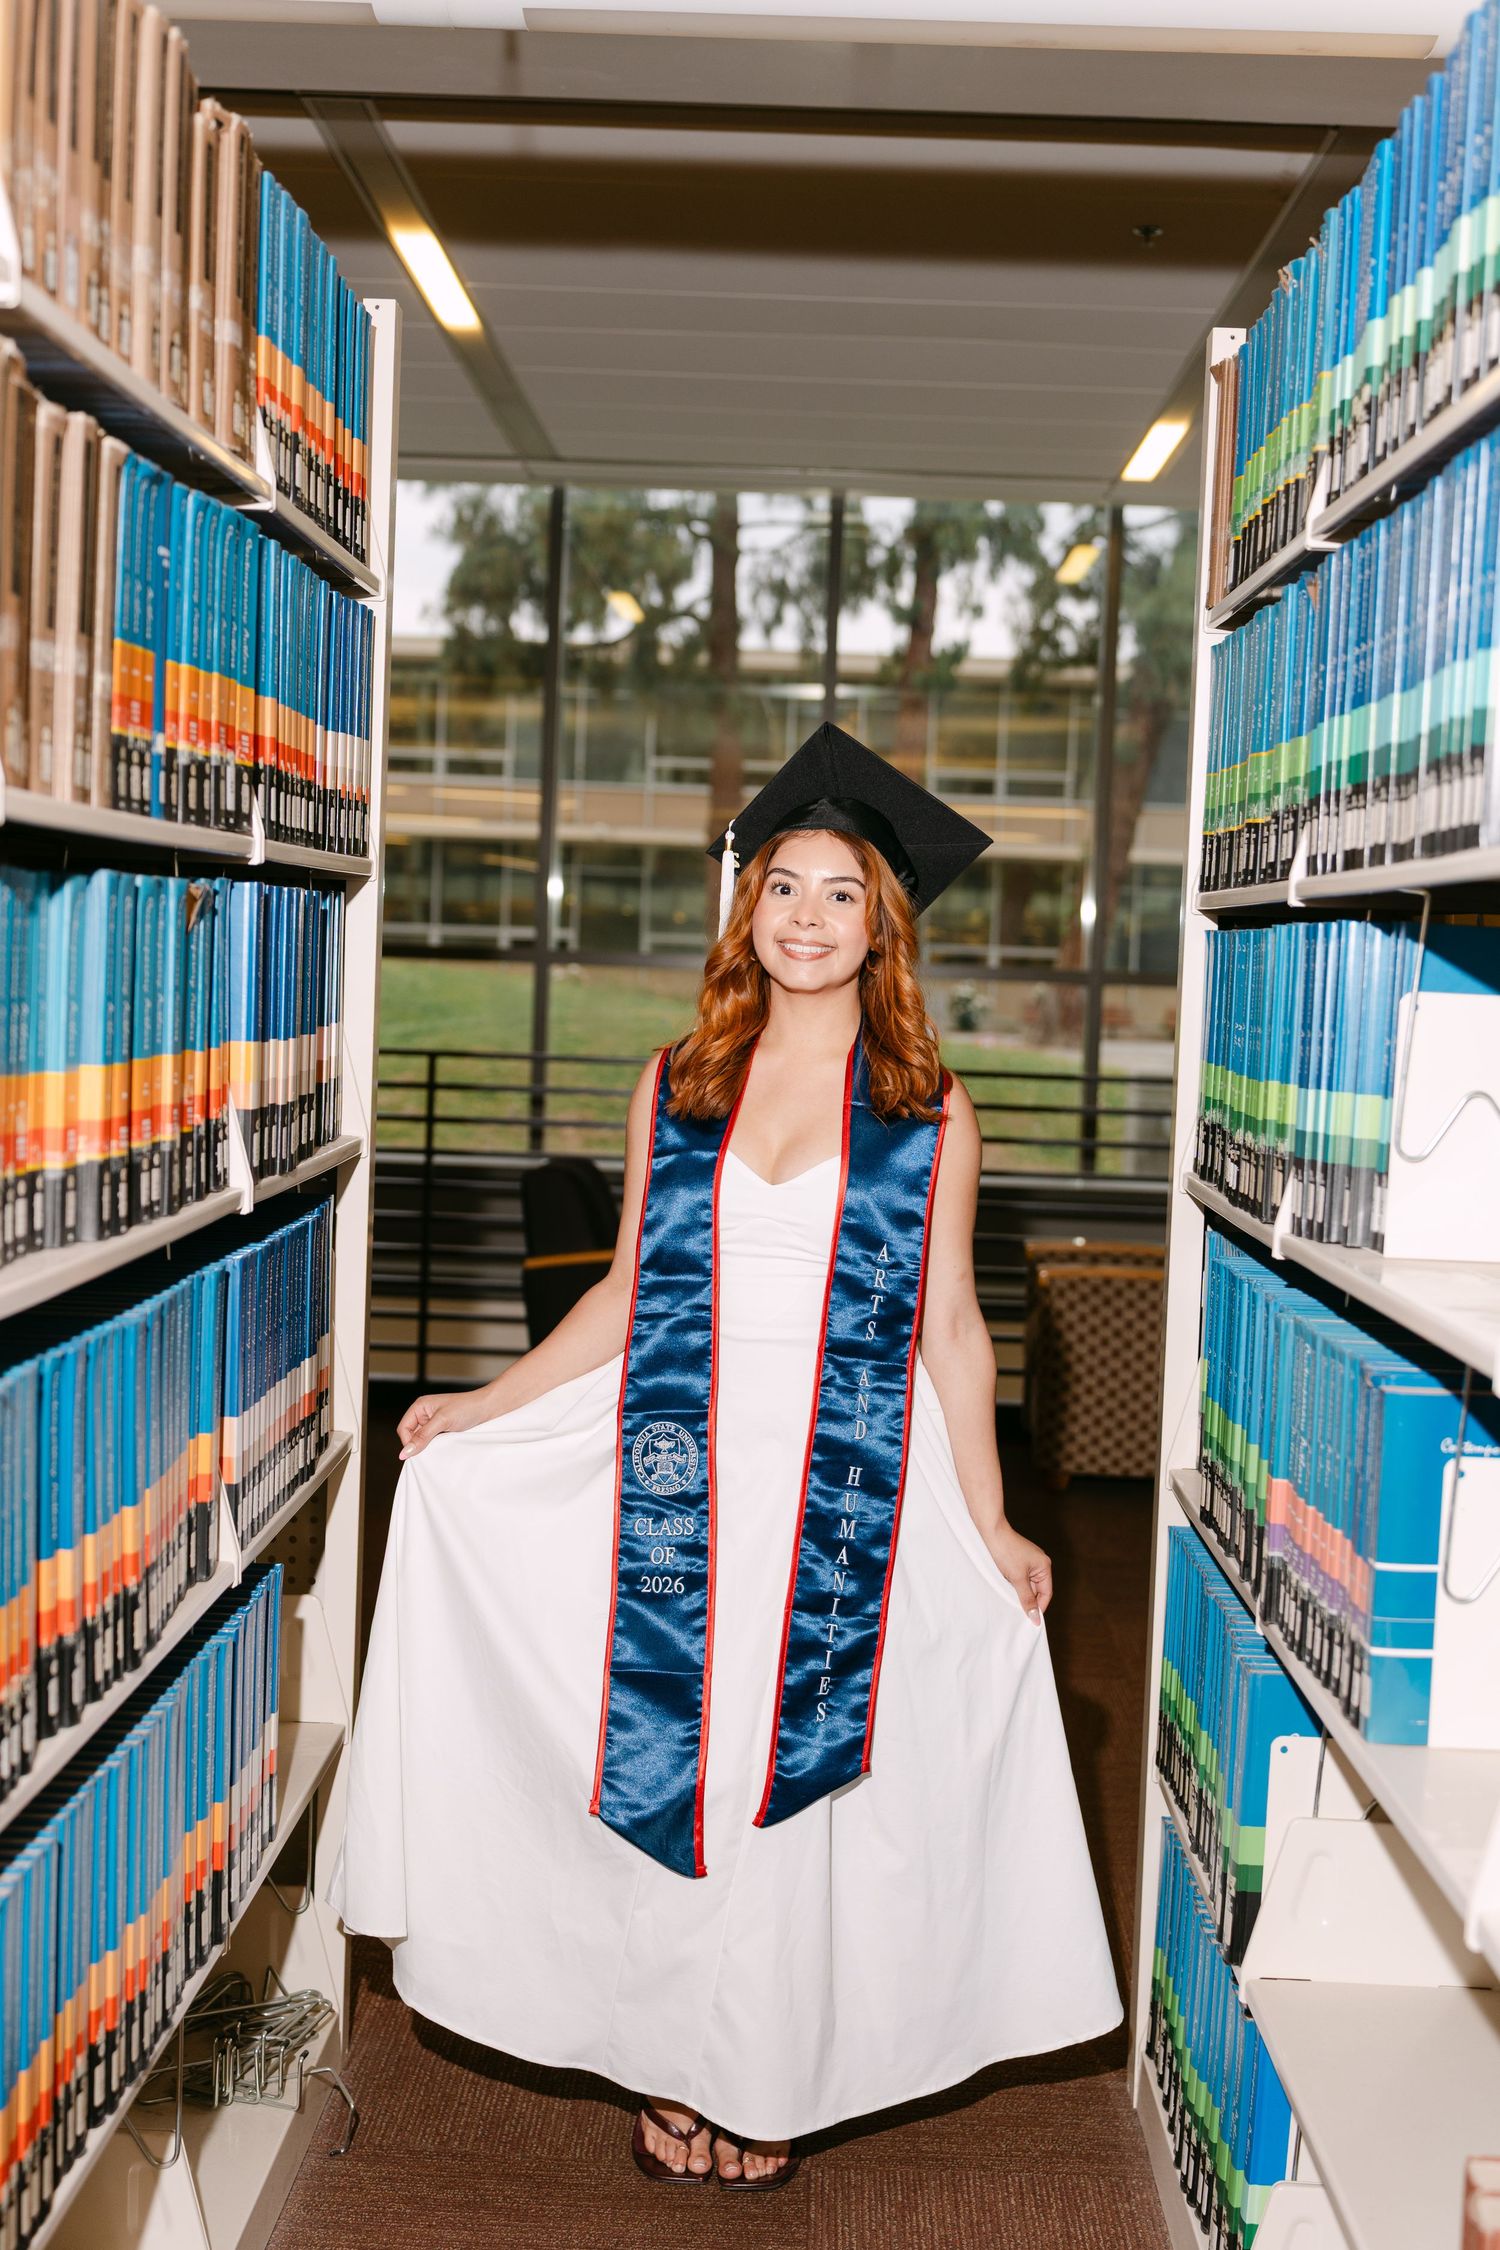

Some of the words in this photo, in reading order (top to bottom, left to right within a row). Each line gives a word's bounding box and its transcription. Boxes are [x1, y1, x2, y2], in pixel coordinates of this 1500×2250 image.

[242, 538, 253, 624] Contemporary
[242, 628, 250, 675] Authors
[865, 1242, 890, 1341] ARTS
[853, 1368, 870, 1440] AND
[634, 1431, 651, 1478] CALIFORNIA
[651, 1424, 676, 1433] STATE
[678, 1430, 697, 1477] UNIVERSITY
[652, 1483, 681, 1493] FRESNO
[634, 1517, 694, 1536] CLASS
[650, 1547, 675, 1565] OF
[640, 1576, 685, 1594] 2026
[816, 1466, 863, 1722] HUMANITIES
